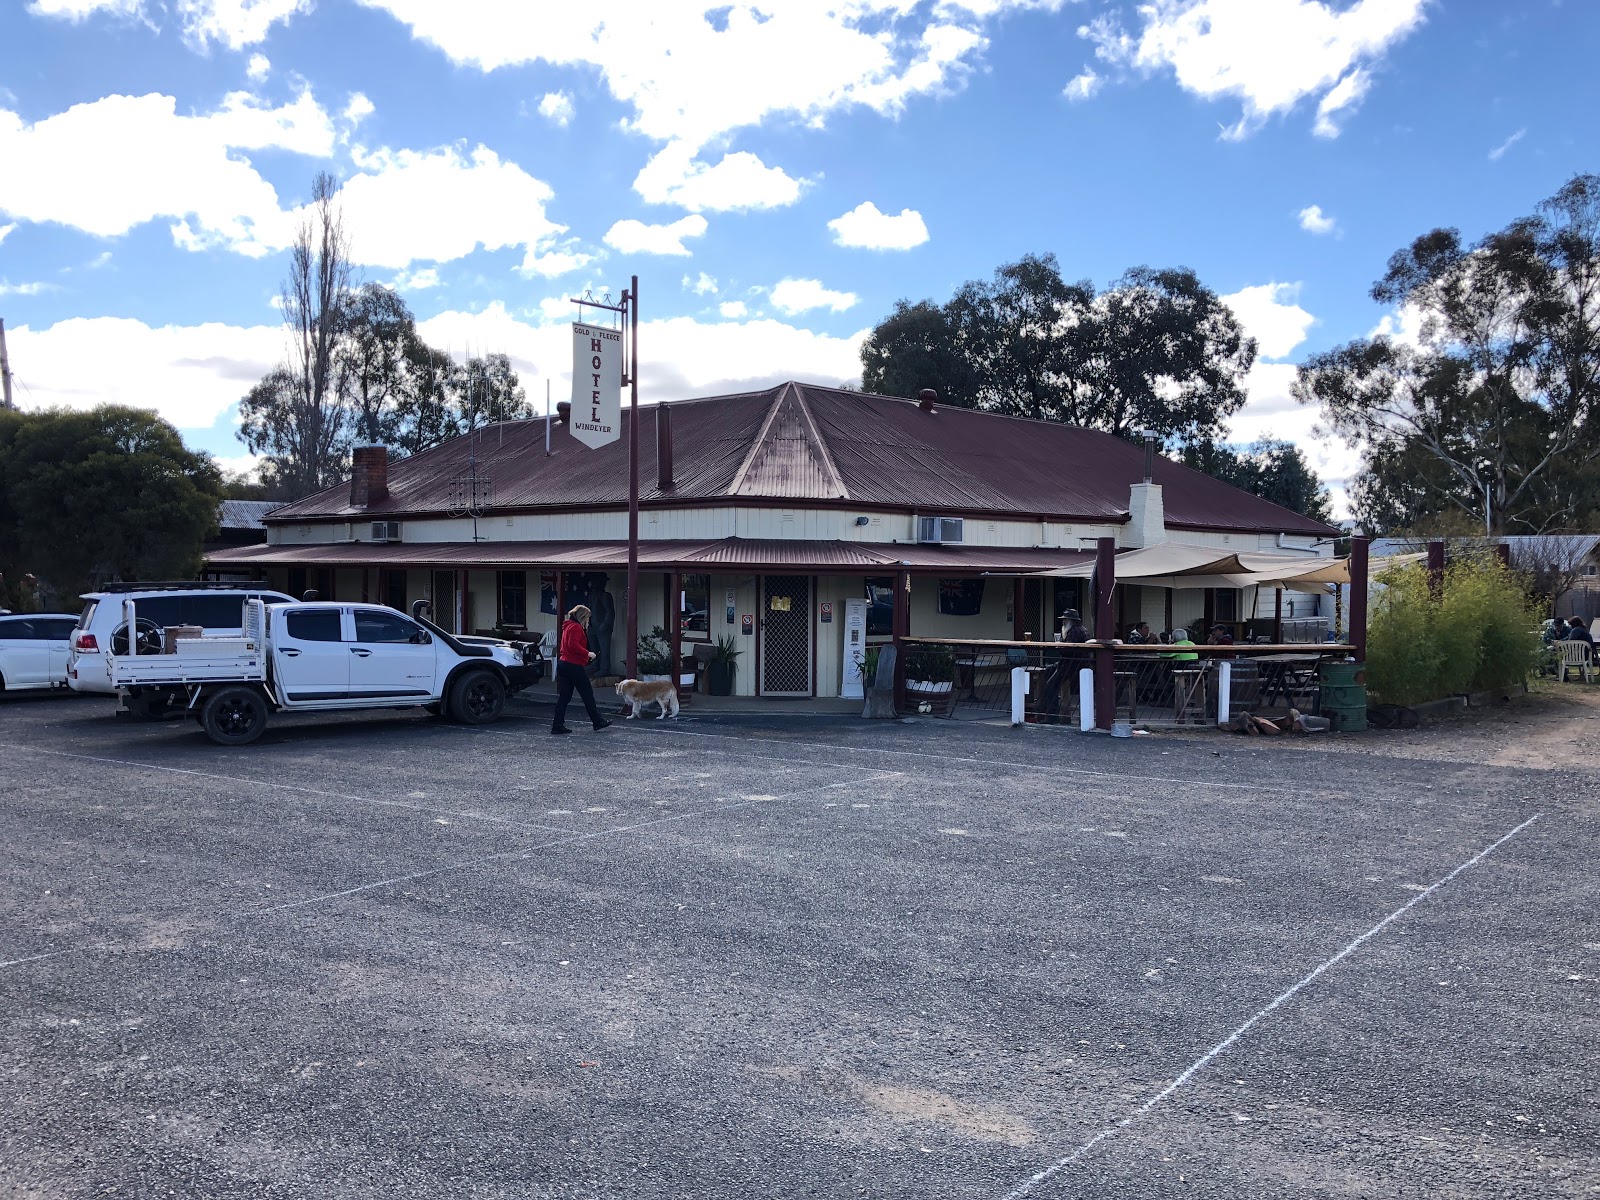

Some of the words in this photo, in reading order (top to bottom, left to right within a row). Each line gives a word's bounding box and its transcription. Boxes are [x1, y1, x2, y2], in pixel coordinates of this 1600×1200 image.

[574, 327, 590, 336] GOLD
[599, 332, 620, 342] FLEECE
[591, 338, 602, 423] HOTEL
[575, 422, 612, 433] WINDEYER
